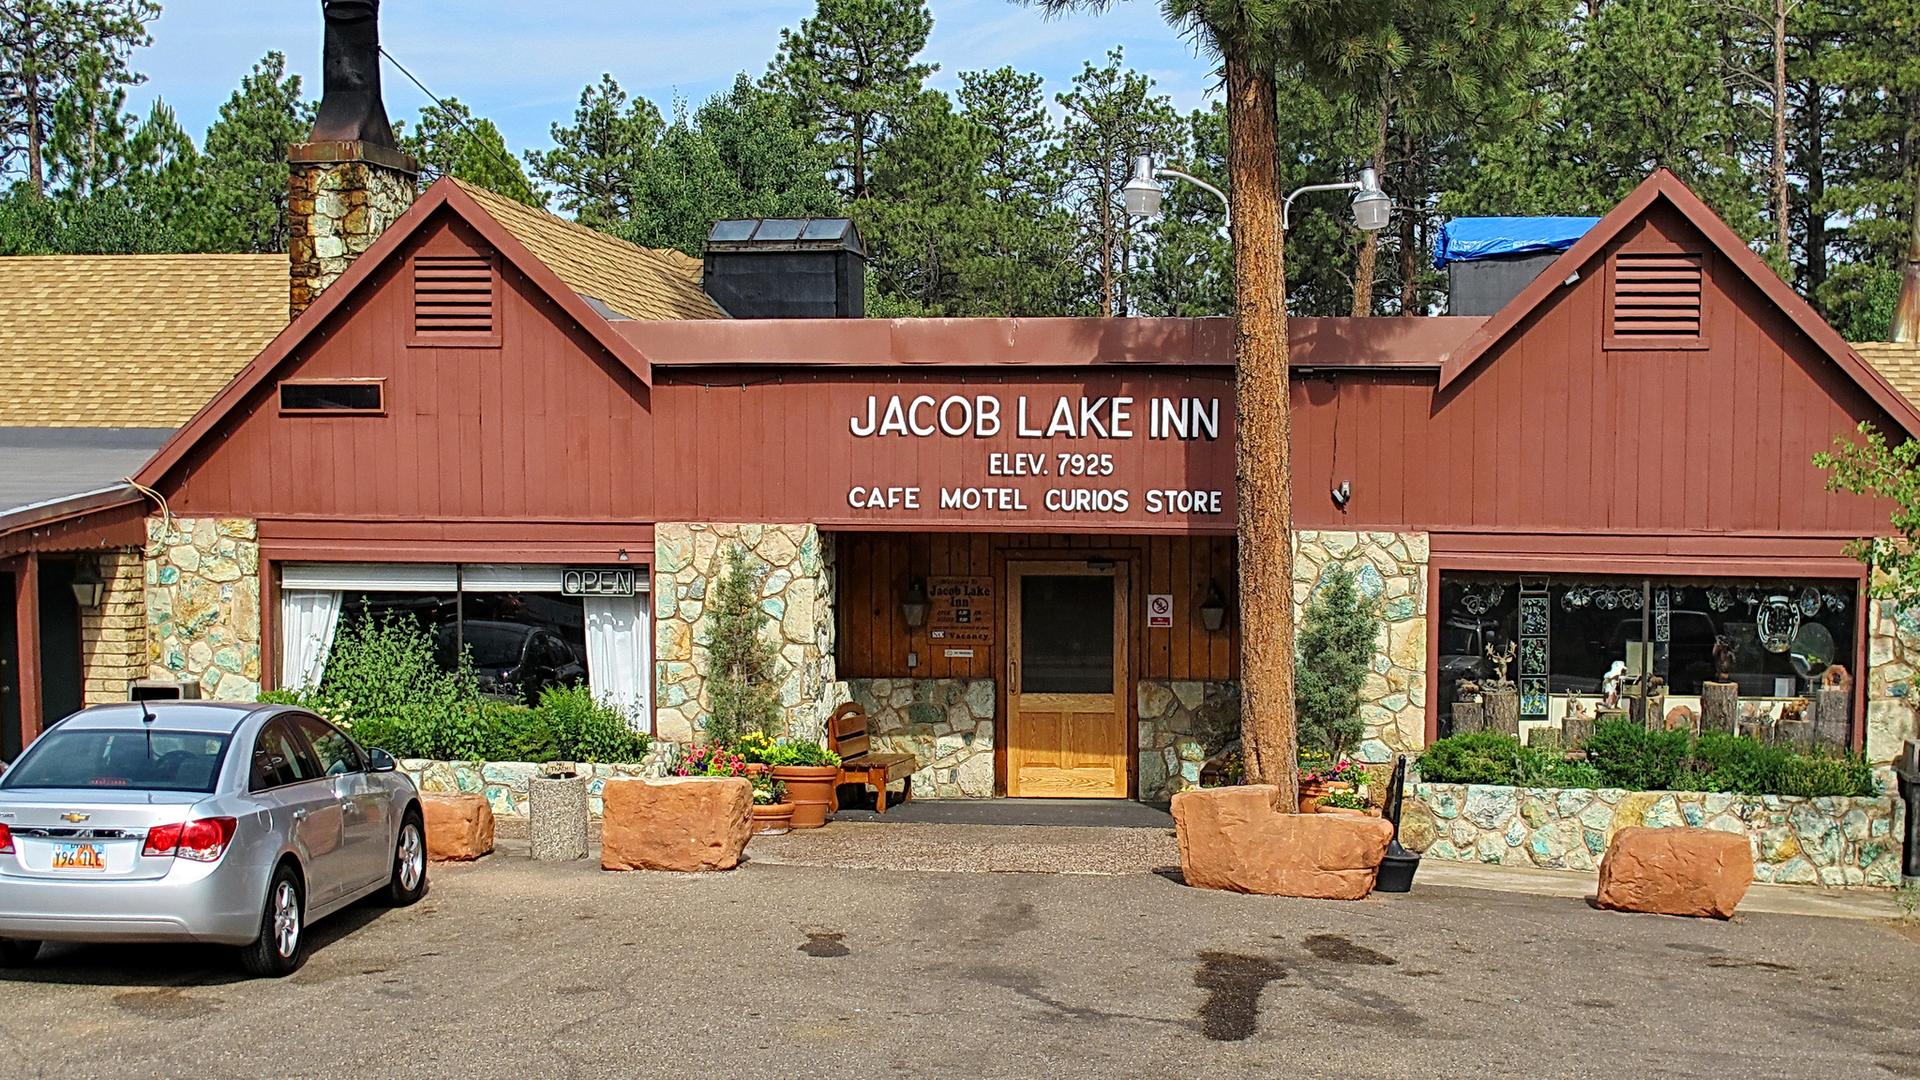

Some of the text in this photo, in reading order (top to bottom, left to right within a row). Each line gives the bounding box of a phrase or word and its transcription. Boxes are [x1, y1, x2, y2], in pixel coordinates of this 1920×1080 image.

[850, 395, 1219, 439] JACOB LAKE INN
[989, 453, 1114, 476] ELEV. 7925
[849, 486, 1222, 513] CAFE MOTEL CURIOS STORE
[564, 570, 631, 594] OPEN
[930, 585, 990, 597] Jacob Lake
[951, 597, 969, 607] Inn
[949, 632, 989, 641] Vacancy
